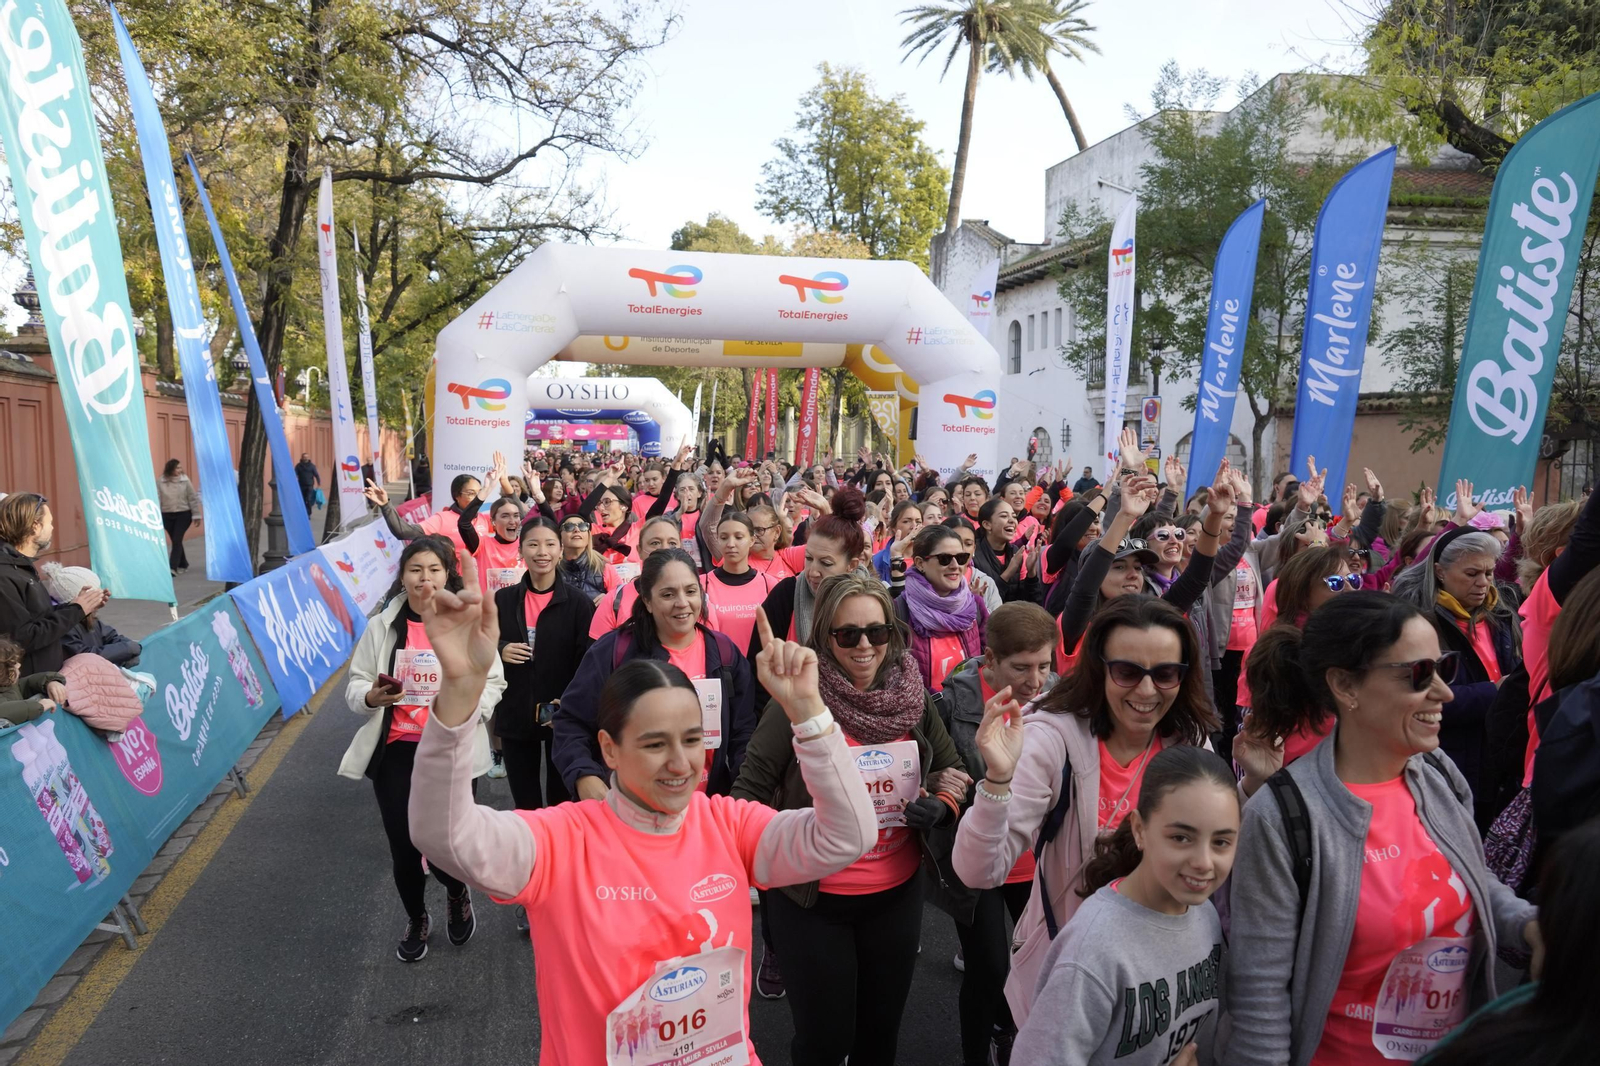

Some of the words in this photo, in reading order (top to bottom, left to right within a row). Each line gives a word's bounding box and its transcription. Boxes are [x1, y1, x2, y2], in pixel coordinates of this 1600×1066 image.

[628, 304, 703, 317] TotalEnergies
[778, 309, 848, 322] TotalEnergies
[1466, 170, 1578, 445] Batiste
[1306, 262, 1365, 407] Marlene
[664, 346, 700, 354] Deportes
[1202, 298, 1239, 423] Marlene
[546, 383, 629, 401] OYSHO
[805, 367, 819, 423] Santander
[446, 416, 511, 429] TotalEnergies
[942, 424, 995, 435] TotalEnergies
[444, 463, 494, 473] totalenergie
[413, 673, 438, 683] 016
[165, 641, 209, 741] Batiste
[133, 756, 158, 782] ESPAÑA
[859, 758, 892, 767] ASTURIANA
[1099, 797, 1130, 811] SHO
[1363, 844, 1401, 864] YSHO
[596, 885, 657, 901] OYSHO
[694, 881, 734, 901] ASTURIANA
[654, 976, 704, 998] ASTURIANA
[658, 1008, 707, 1042] 016
[1114, 977, 1171, 1059] LOS
[673, 1041, 694, 1057] 4191
[705, 1040, 728, 1055] SEVILLA
[1386, 1040, 1428, 1054] OYSHO
